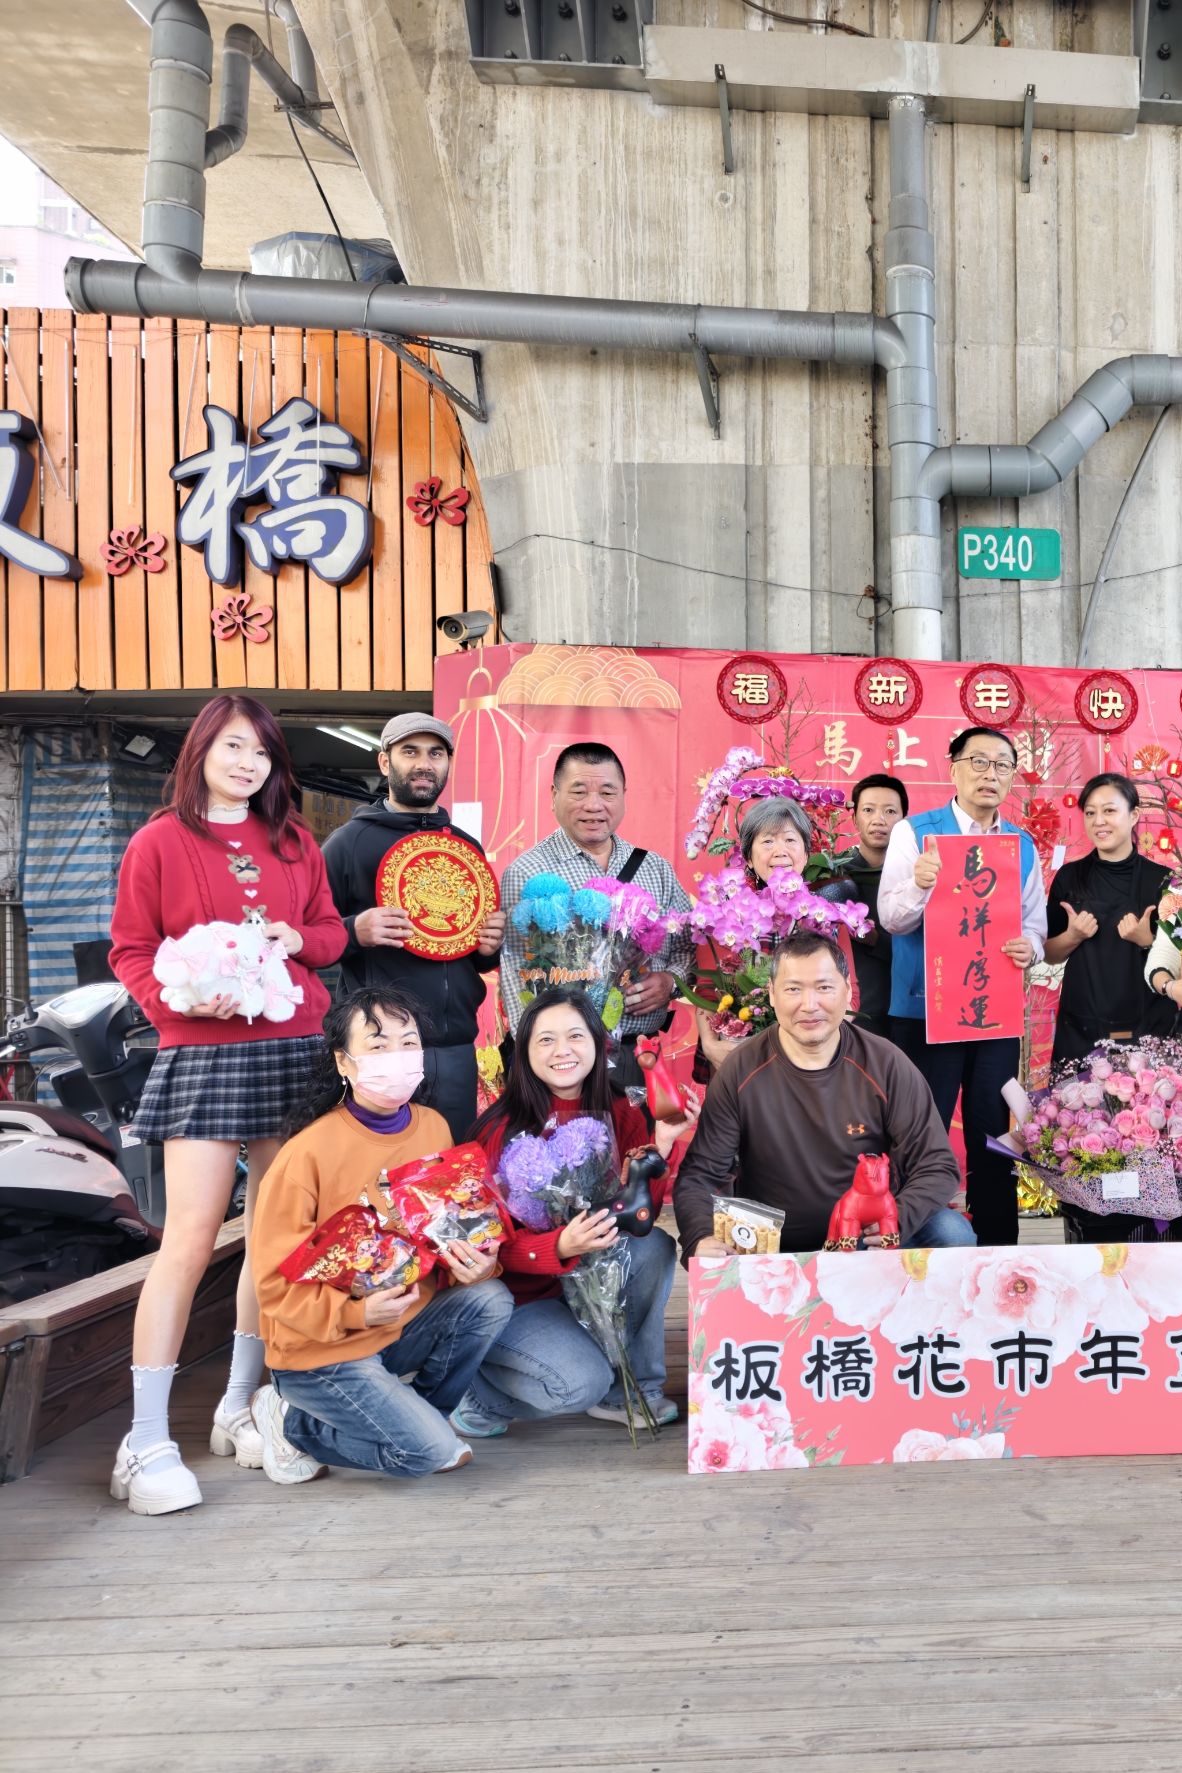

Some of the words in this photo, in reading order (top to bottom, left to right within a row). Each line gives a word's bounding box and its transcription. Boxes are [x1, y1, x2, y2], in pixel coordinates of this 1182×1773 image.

[963, 533, 1033, 572] P340
[816, 720, 1055, 781] 馬上財
